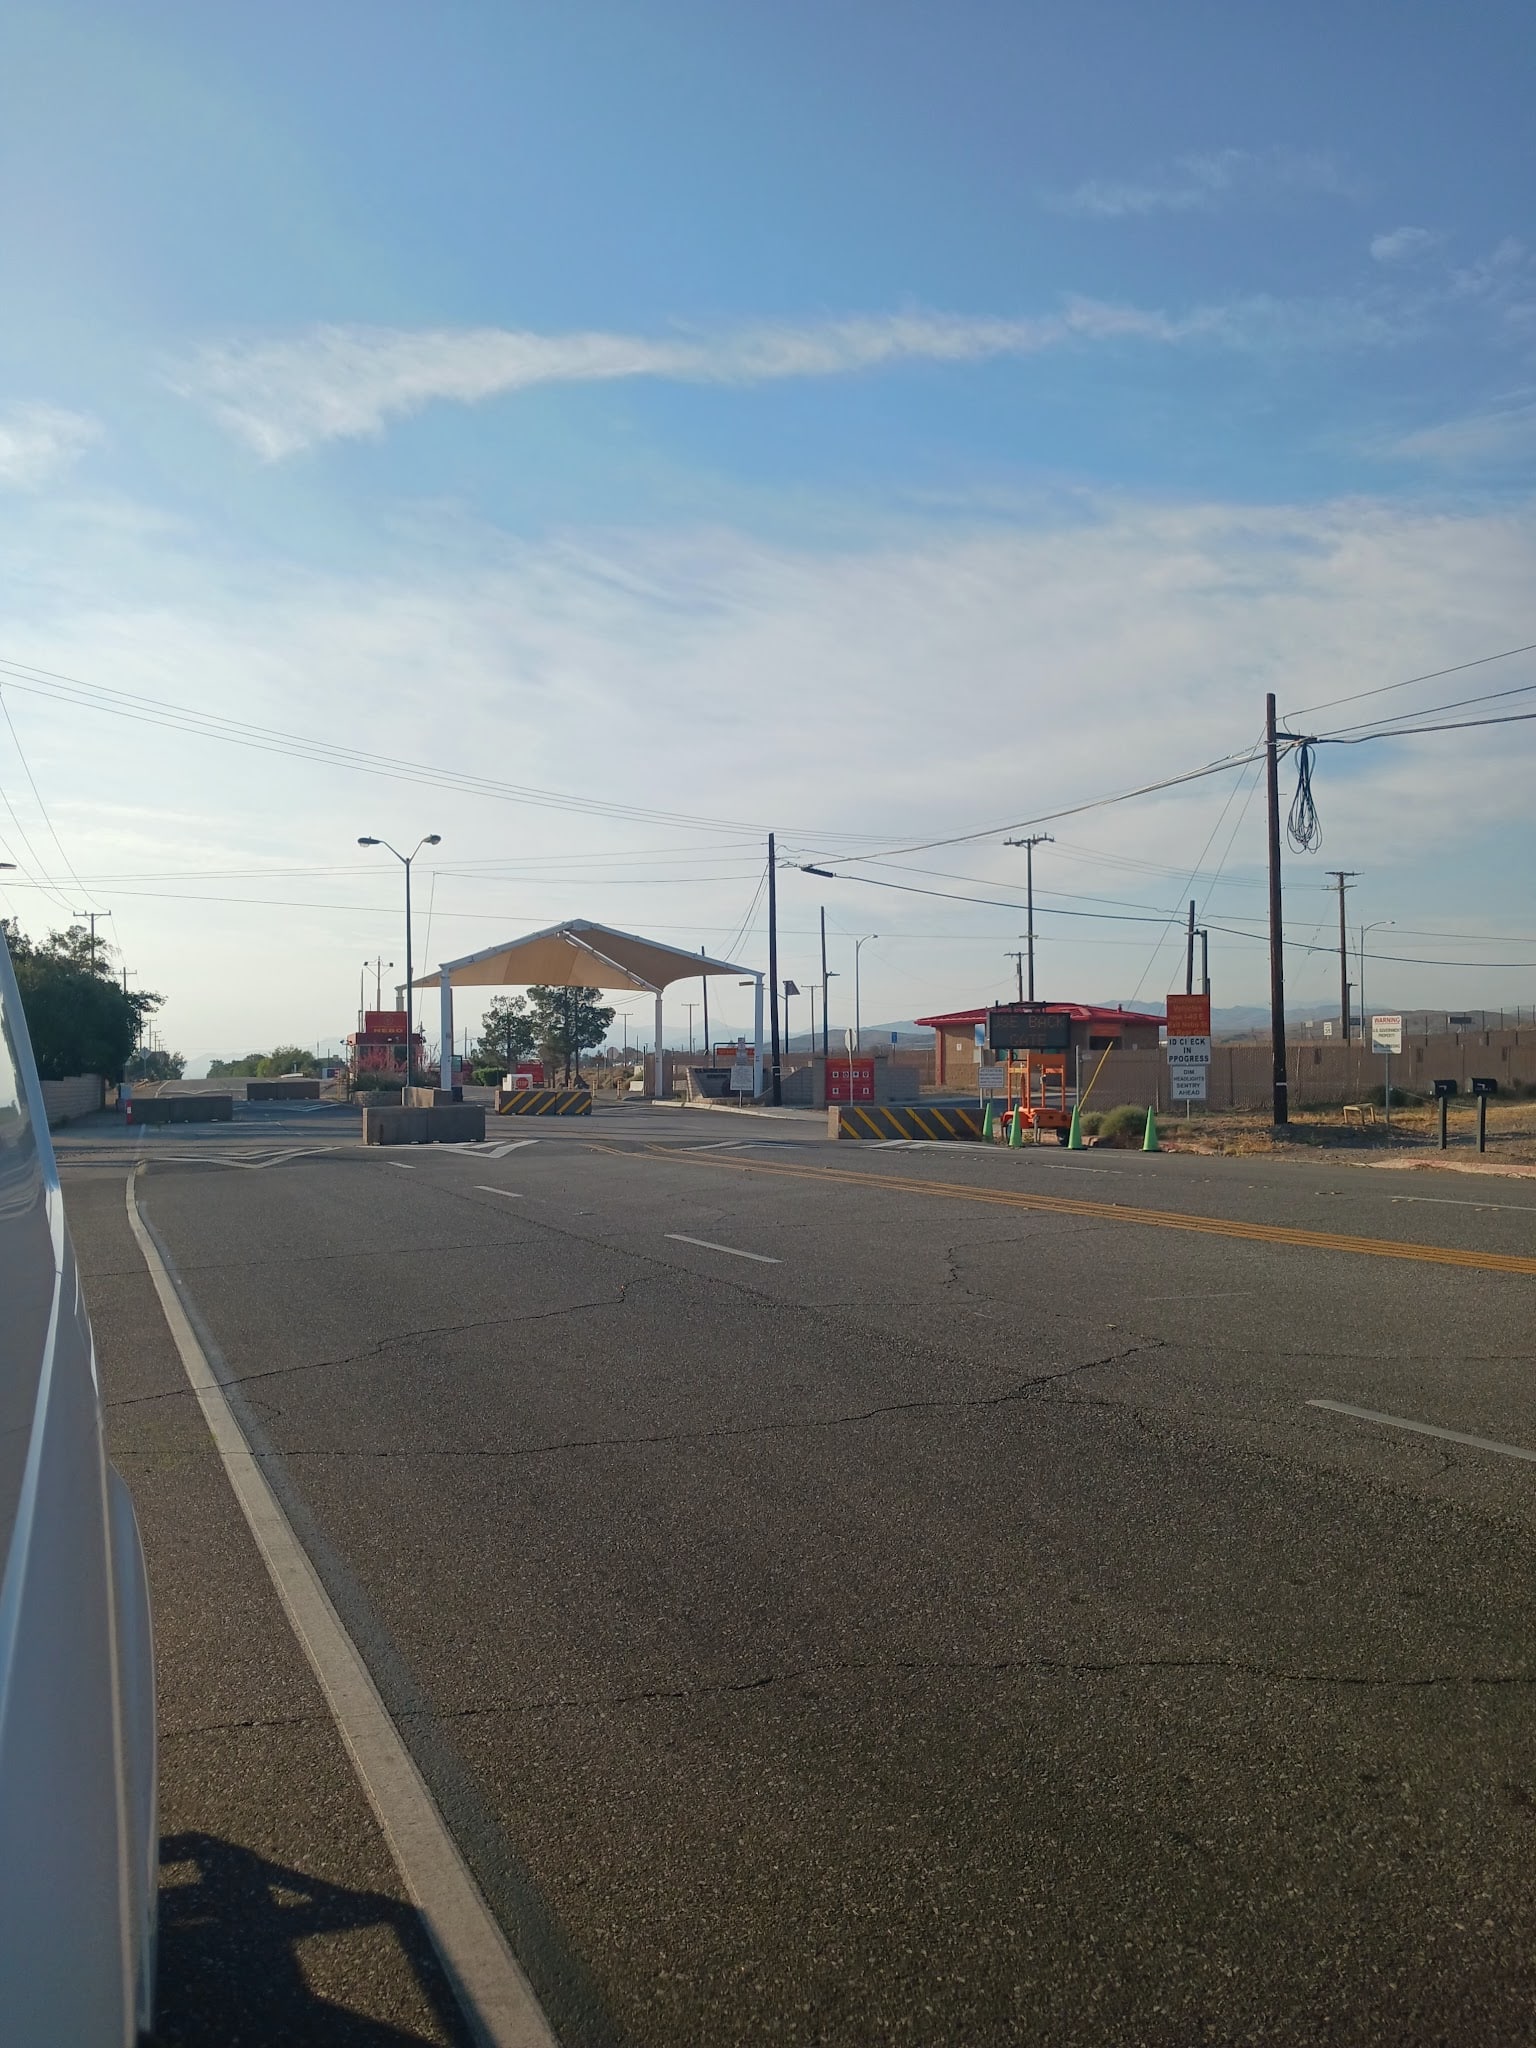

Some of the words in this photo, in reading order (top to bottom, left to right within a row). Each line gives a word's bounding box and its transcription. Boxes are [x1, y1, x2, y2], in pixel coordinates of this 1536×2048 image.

[993, 1015, 1018, 1028] USE
[1029, 1015, 1067, 1028] BACK
[1010, 1033, 1047, 1046] GATE
